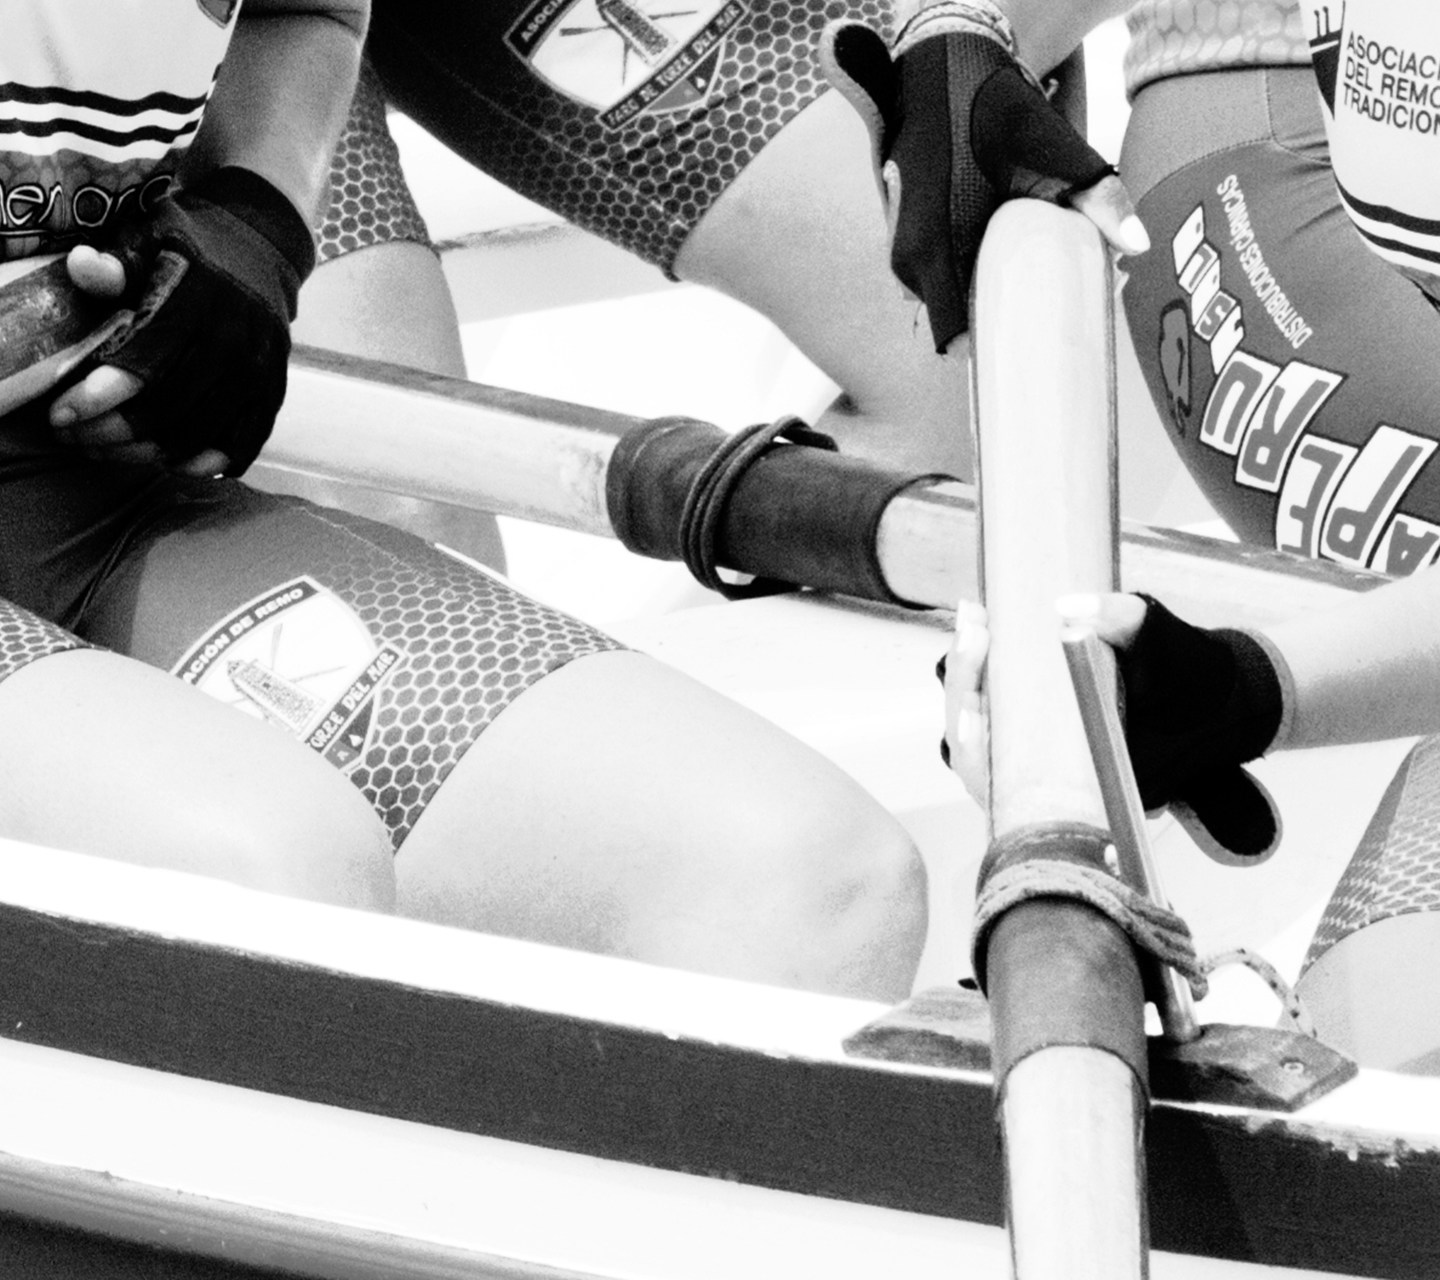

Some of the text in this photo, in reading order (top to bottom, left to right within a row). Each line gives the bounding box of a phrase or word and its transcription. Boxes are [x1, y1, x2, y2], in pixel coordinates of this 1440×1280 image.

[691, 31, 717, 55] DEL
[1345, 56, 1373, 91] DEL
[1239, 241, 1314, 350] DISTRIBUCIONES
[182, 588, 304, 684] ACIÓN DE REMO
[309, 651, 396, 749] ORRE DEL MAR
